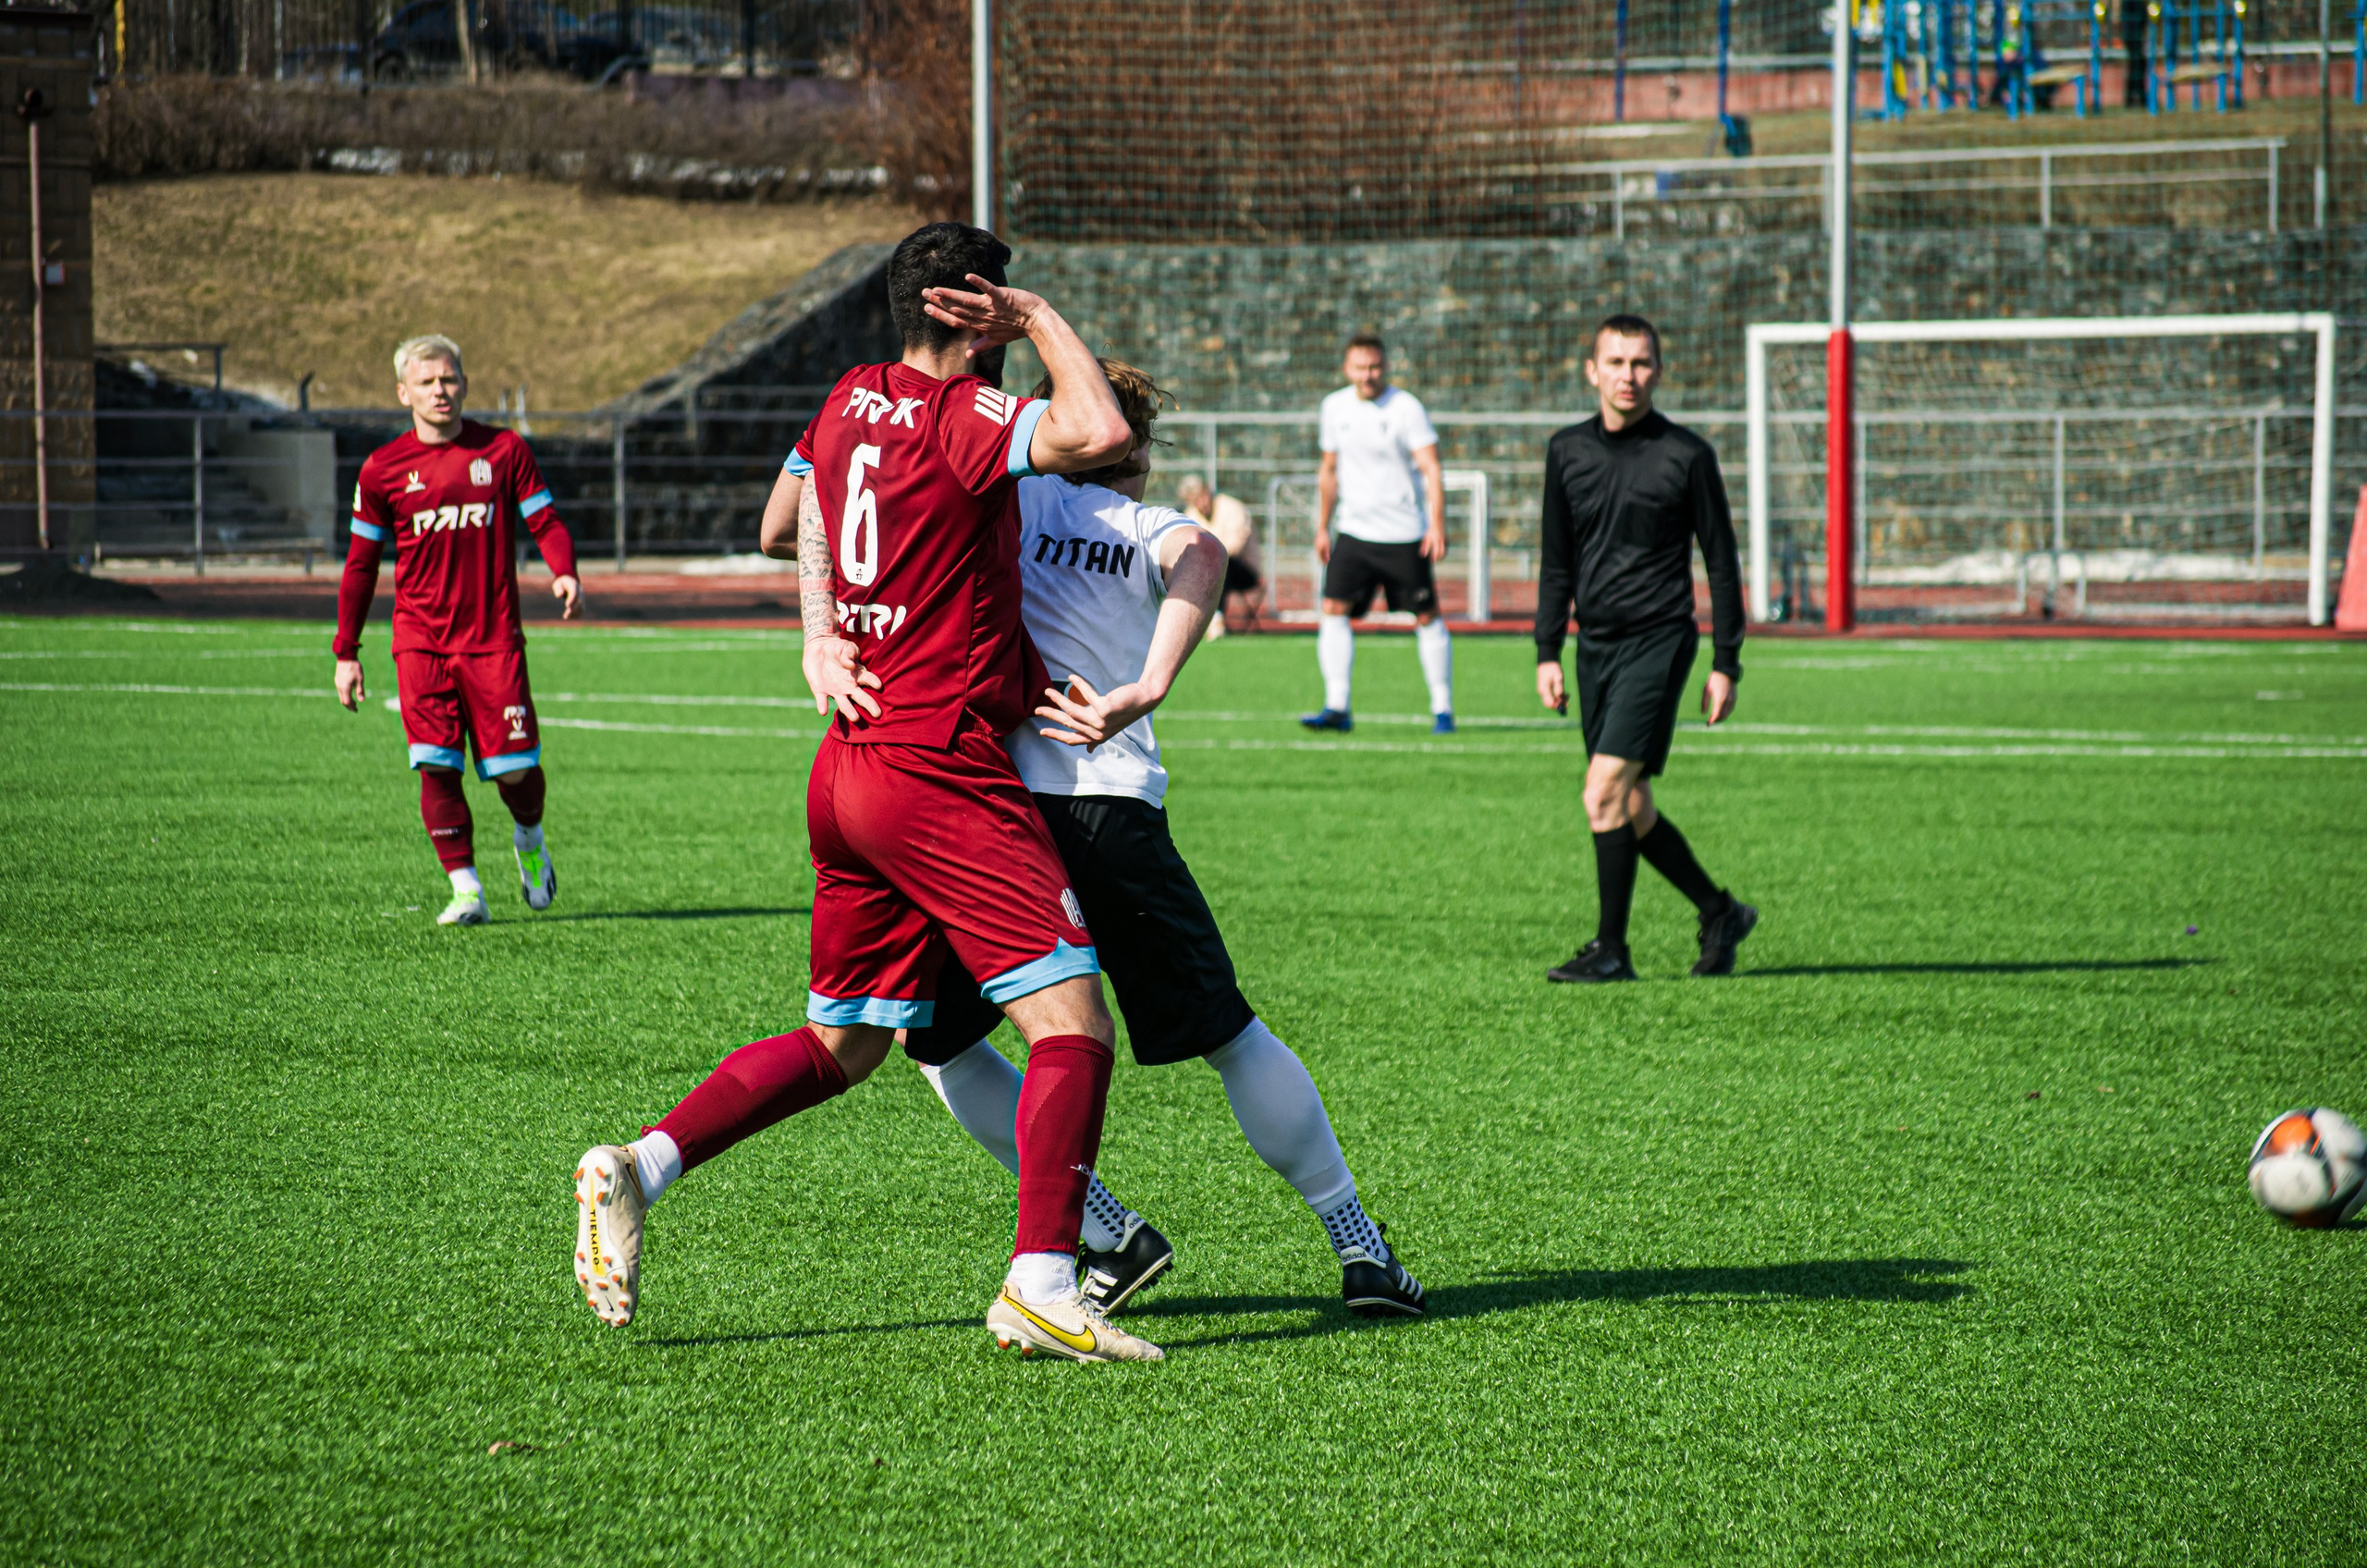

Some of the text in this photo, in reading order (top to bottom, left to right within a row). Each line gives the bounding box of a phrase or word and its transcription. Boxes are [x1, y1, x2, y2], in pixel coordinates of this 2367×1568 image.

[412, 502, 495, 537] PARI
[840, 442, 882, 588] 6
[1034, 533, 1135, 579] TITAN
[589, 1208, 600, 1266] TIEMPO
